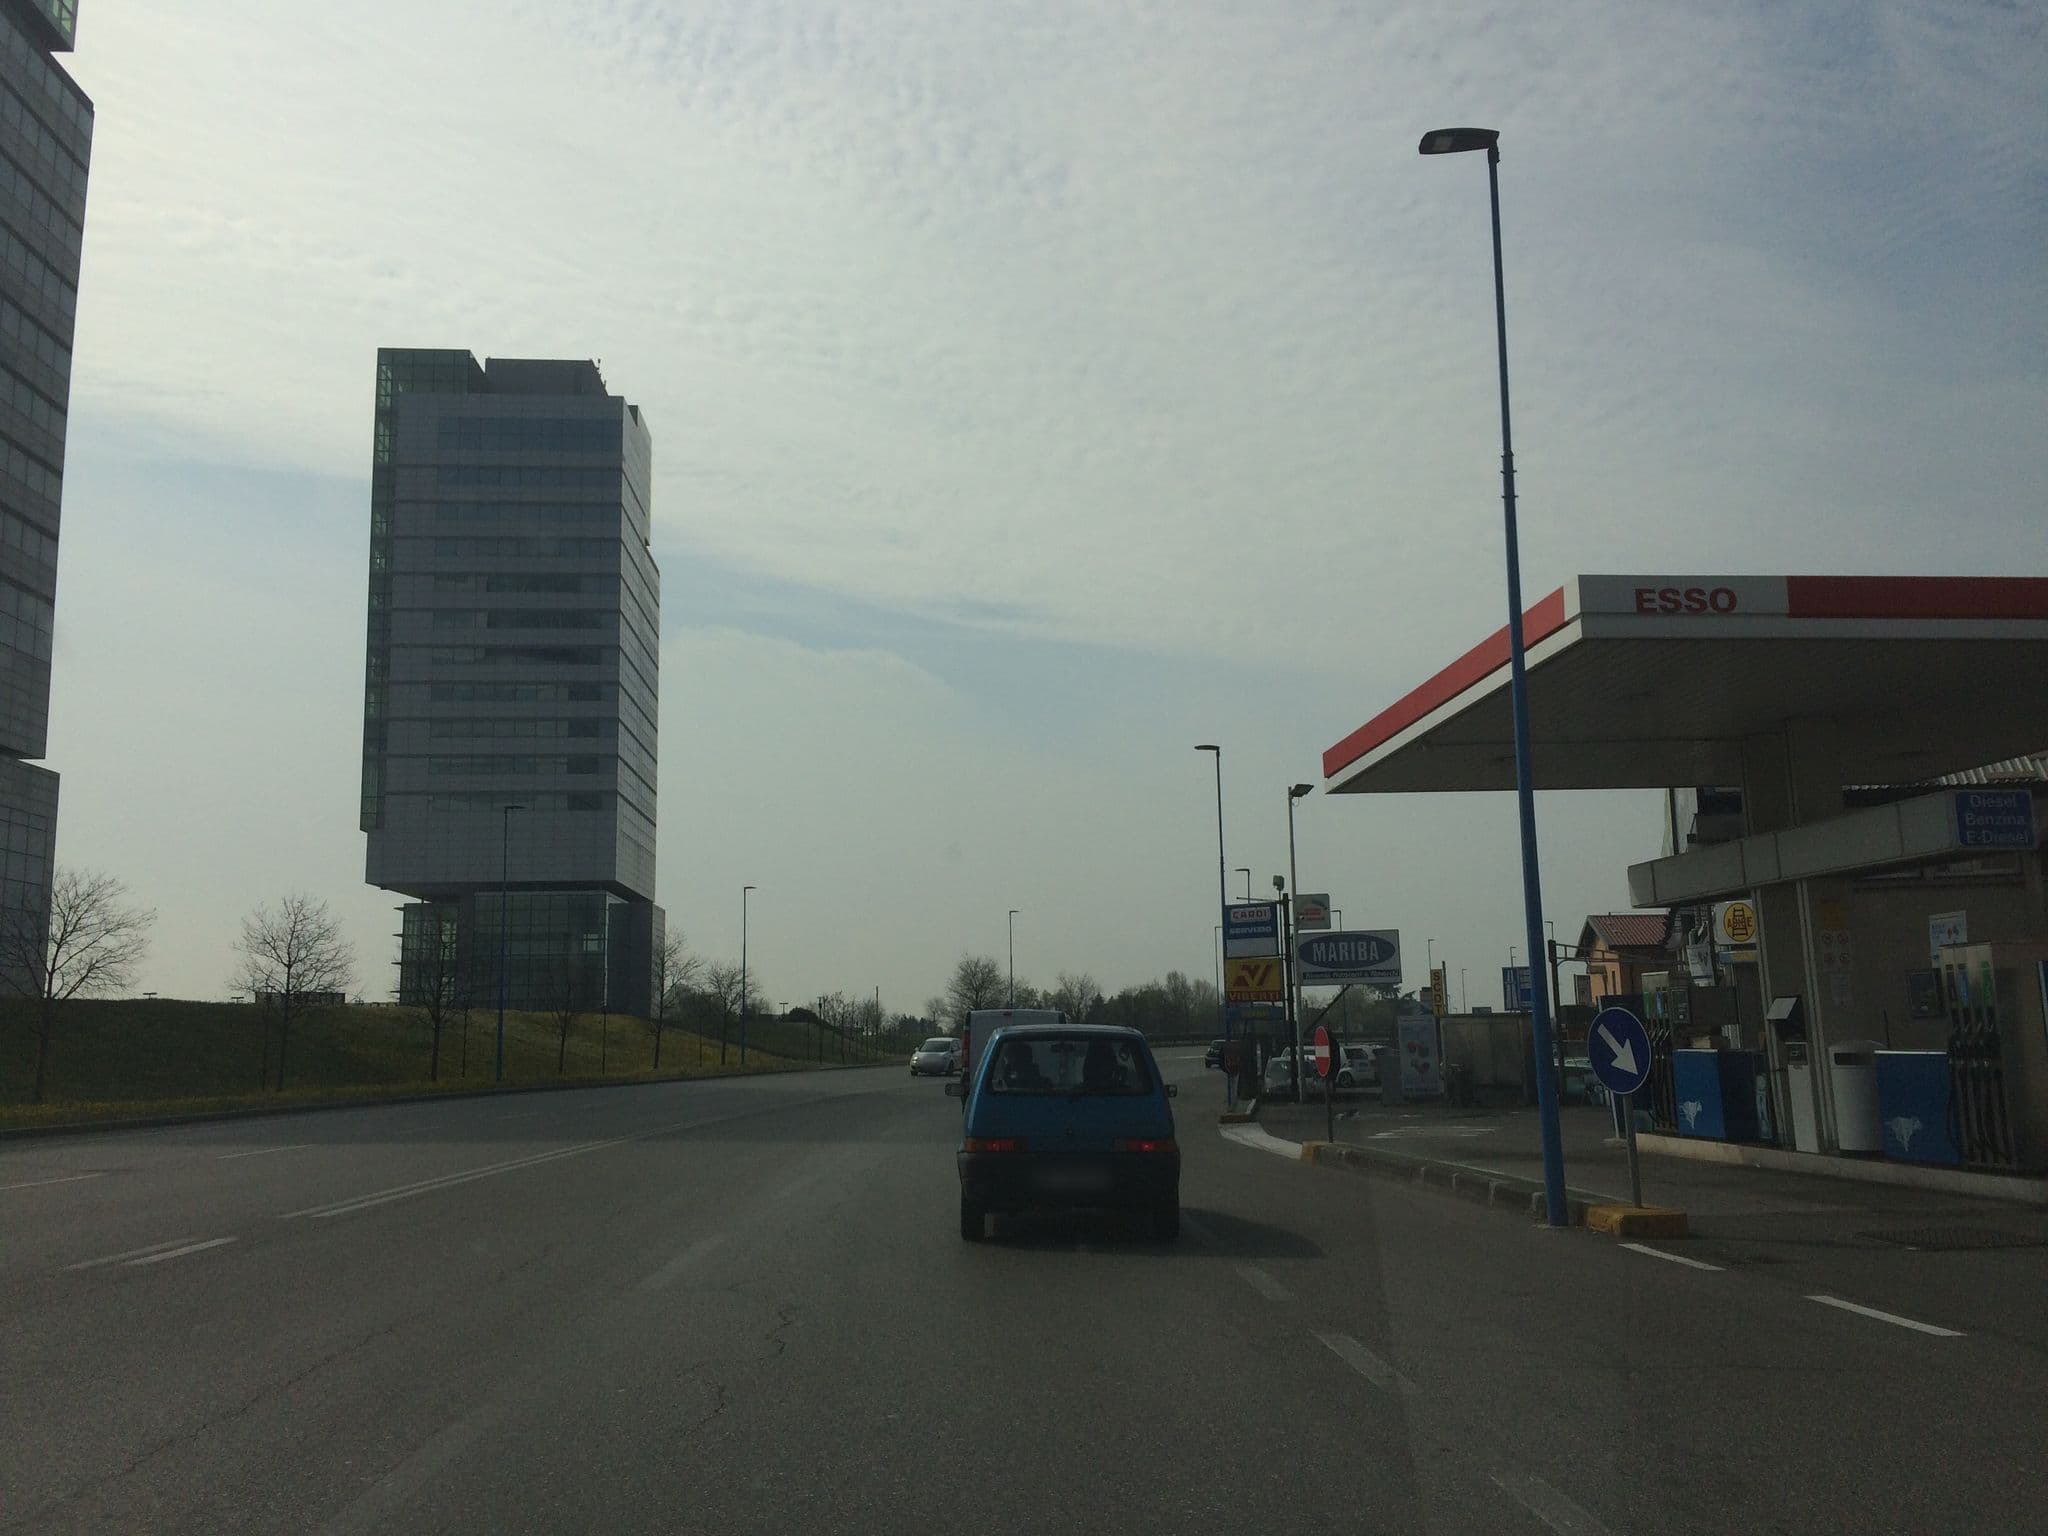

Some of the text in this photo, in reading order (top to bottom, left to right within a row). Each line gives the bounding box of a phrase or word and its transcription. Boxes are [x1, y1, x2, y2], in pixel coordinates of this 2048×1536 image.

[1634, 587, 1737, 614] ESSO
[1969, 794, 2016, 808] Diesel
[1966, 812, 2027, 826] Benzina
[1312, 941, 1379, 962] MARIBA
